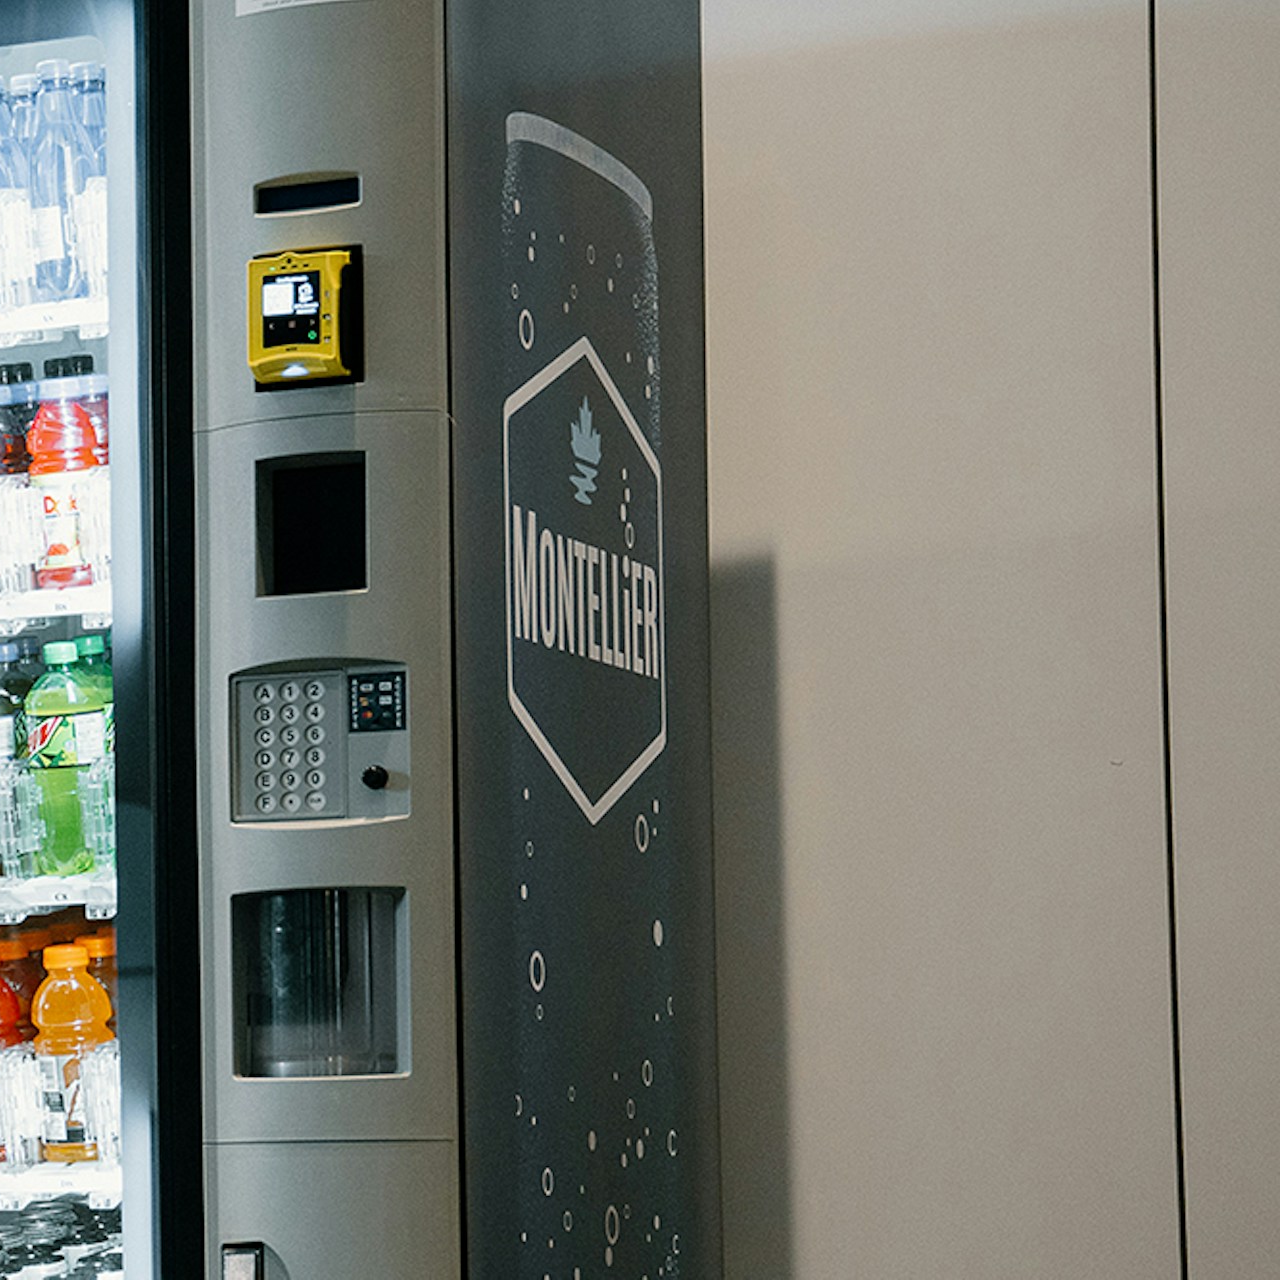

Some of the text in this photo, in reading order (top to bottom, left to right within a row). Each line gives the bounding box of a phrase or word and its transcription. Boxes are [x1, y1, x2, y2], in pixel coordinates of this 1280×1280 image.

[260, 688, 270, 699] A
[286, 686, 292, 696] 1
[310, 685, 319, 696] 2
[286, 709, 294, 720] 3
[311, 707, 319, 717] 4
[260, 732, 270, 743] C
[286, 731, 294, 741] 5
[311, 729, 319, 740] 6
[261, 754, 271, 765] D
[286, 753, 294, 763] 7
[262, 776, 270, 787] E
[286, 775, 294, 785] 9
[312, 773, 319, 784] 0
[262, 798, 270, 809] F
